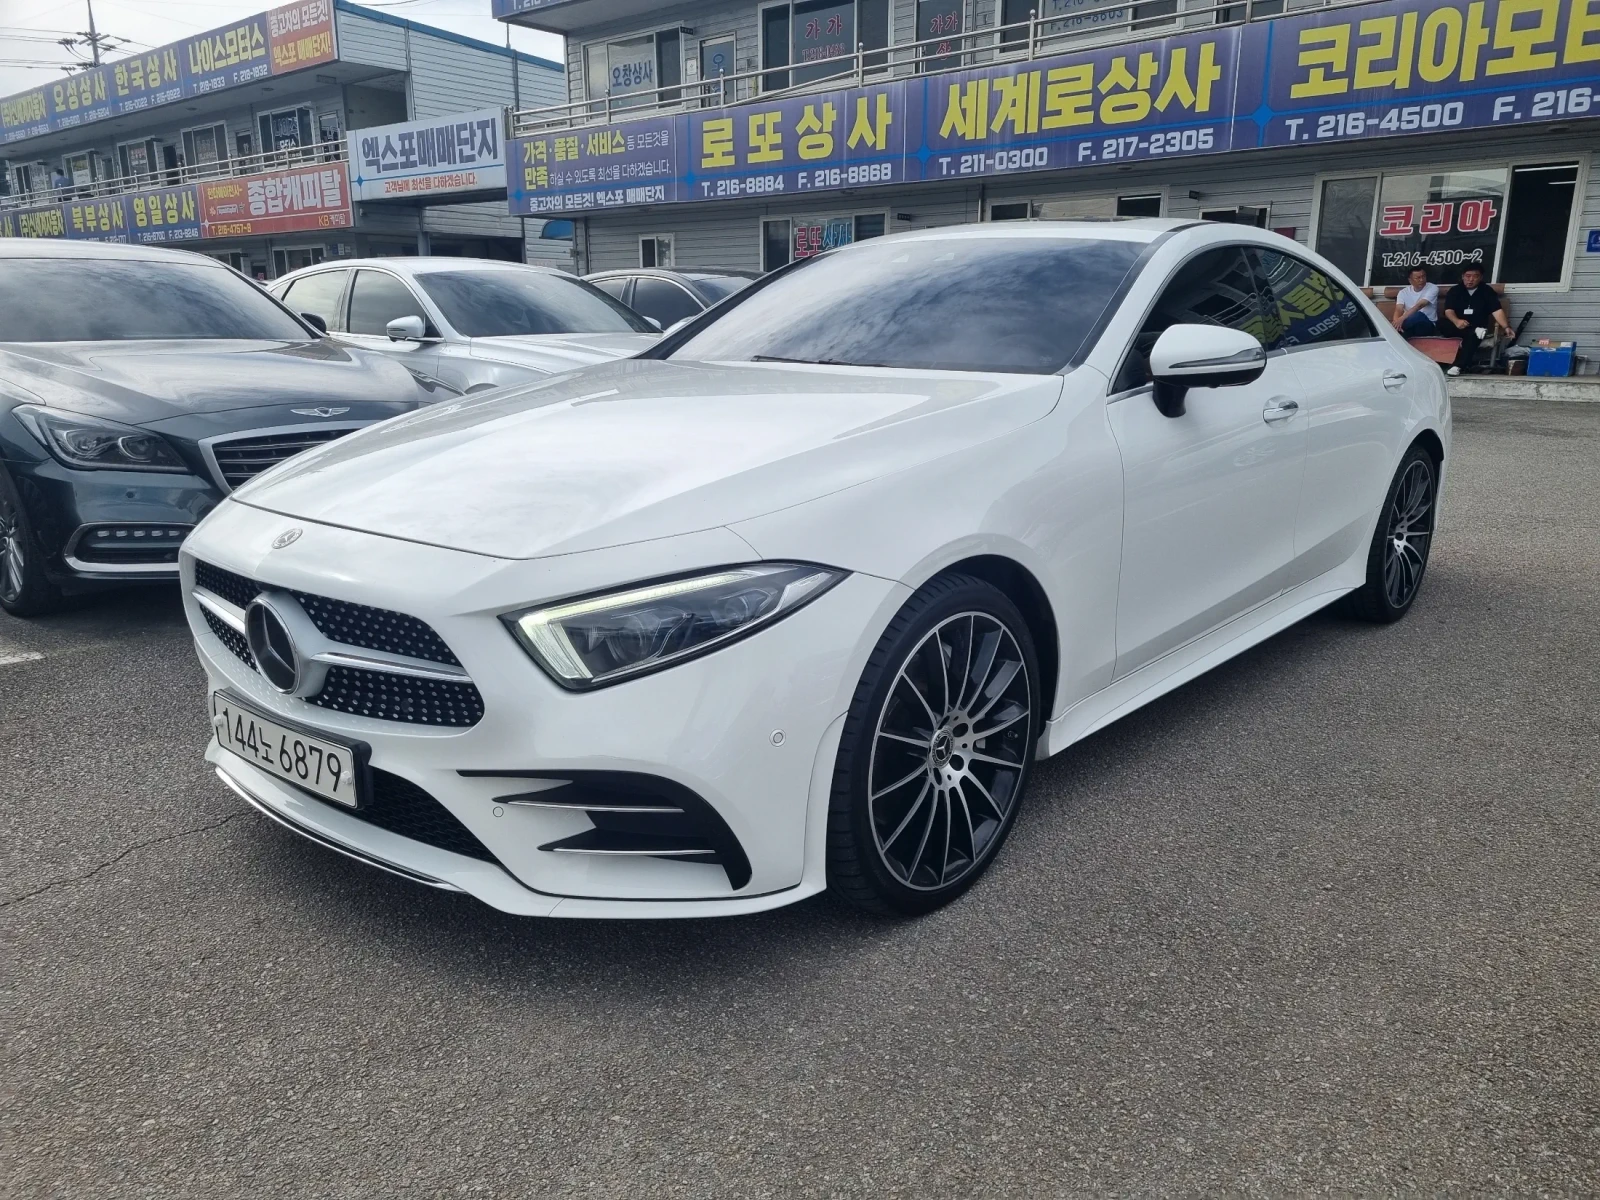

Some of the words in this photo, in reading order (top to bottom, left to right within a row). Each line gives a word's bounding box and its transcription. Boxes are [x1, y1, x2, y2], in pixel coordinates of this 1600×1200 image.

[270, 10, 300, 37] 중고차의
[188, 23, 266, 74] 나이스모터스
[114, 48, 177, 96] 한국상사
[612, 60, 653, 87] 오창상사
[53, 71, 106, 112] 오성상사
[939, 42, 1221, 140] 세계로상사
[361, 117, 498, 174] 엑스포매매단지
[627, 135, 635, 150] 등
[637, 129, 669, 149] 모든것을
[701, 93, 892, 169] 로또상사
[411, 177, 432, 191] 최선을
[433, 172, 478, 188] 다하겠습니다.
[566, 172, 573, 184] 수
[574, 167, 596, 184] 있도록
[598, 163, 621, 180] 최선을
[622, 158, 672, 177] 다하겠습니다.
[133, 190, 195, 227] 영일상사
[247, 169, 342, 216] 종합캐피탈
[529, 195, 563, 212] 중고차의
[565, 193, 594, 210] 모든것!
[596, 188, 624, 206] 엑스포
[626, 185, 665, 203] 매매단지
[71, 201, 123, 232] 북부상사
[1379, 200, 1497, 236] 코리아
